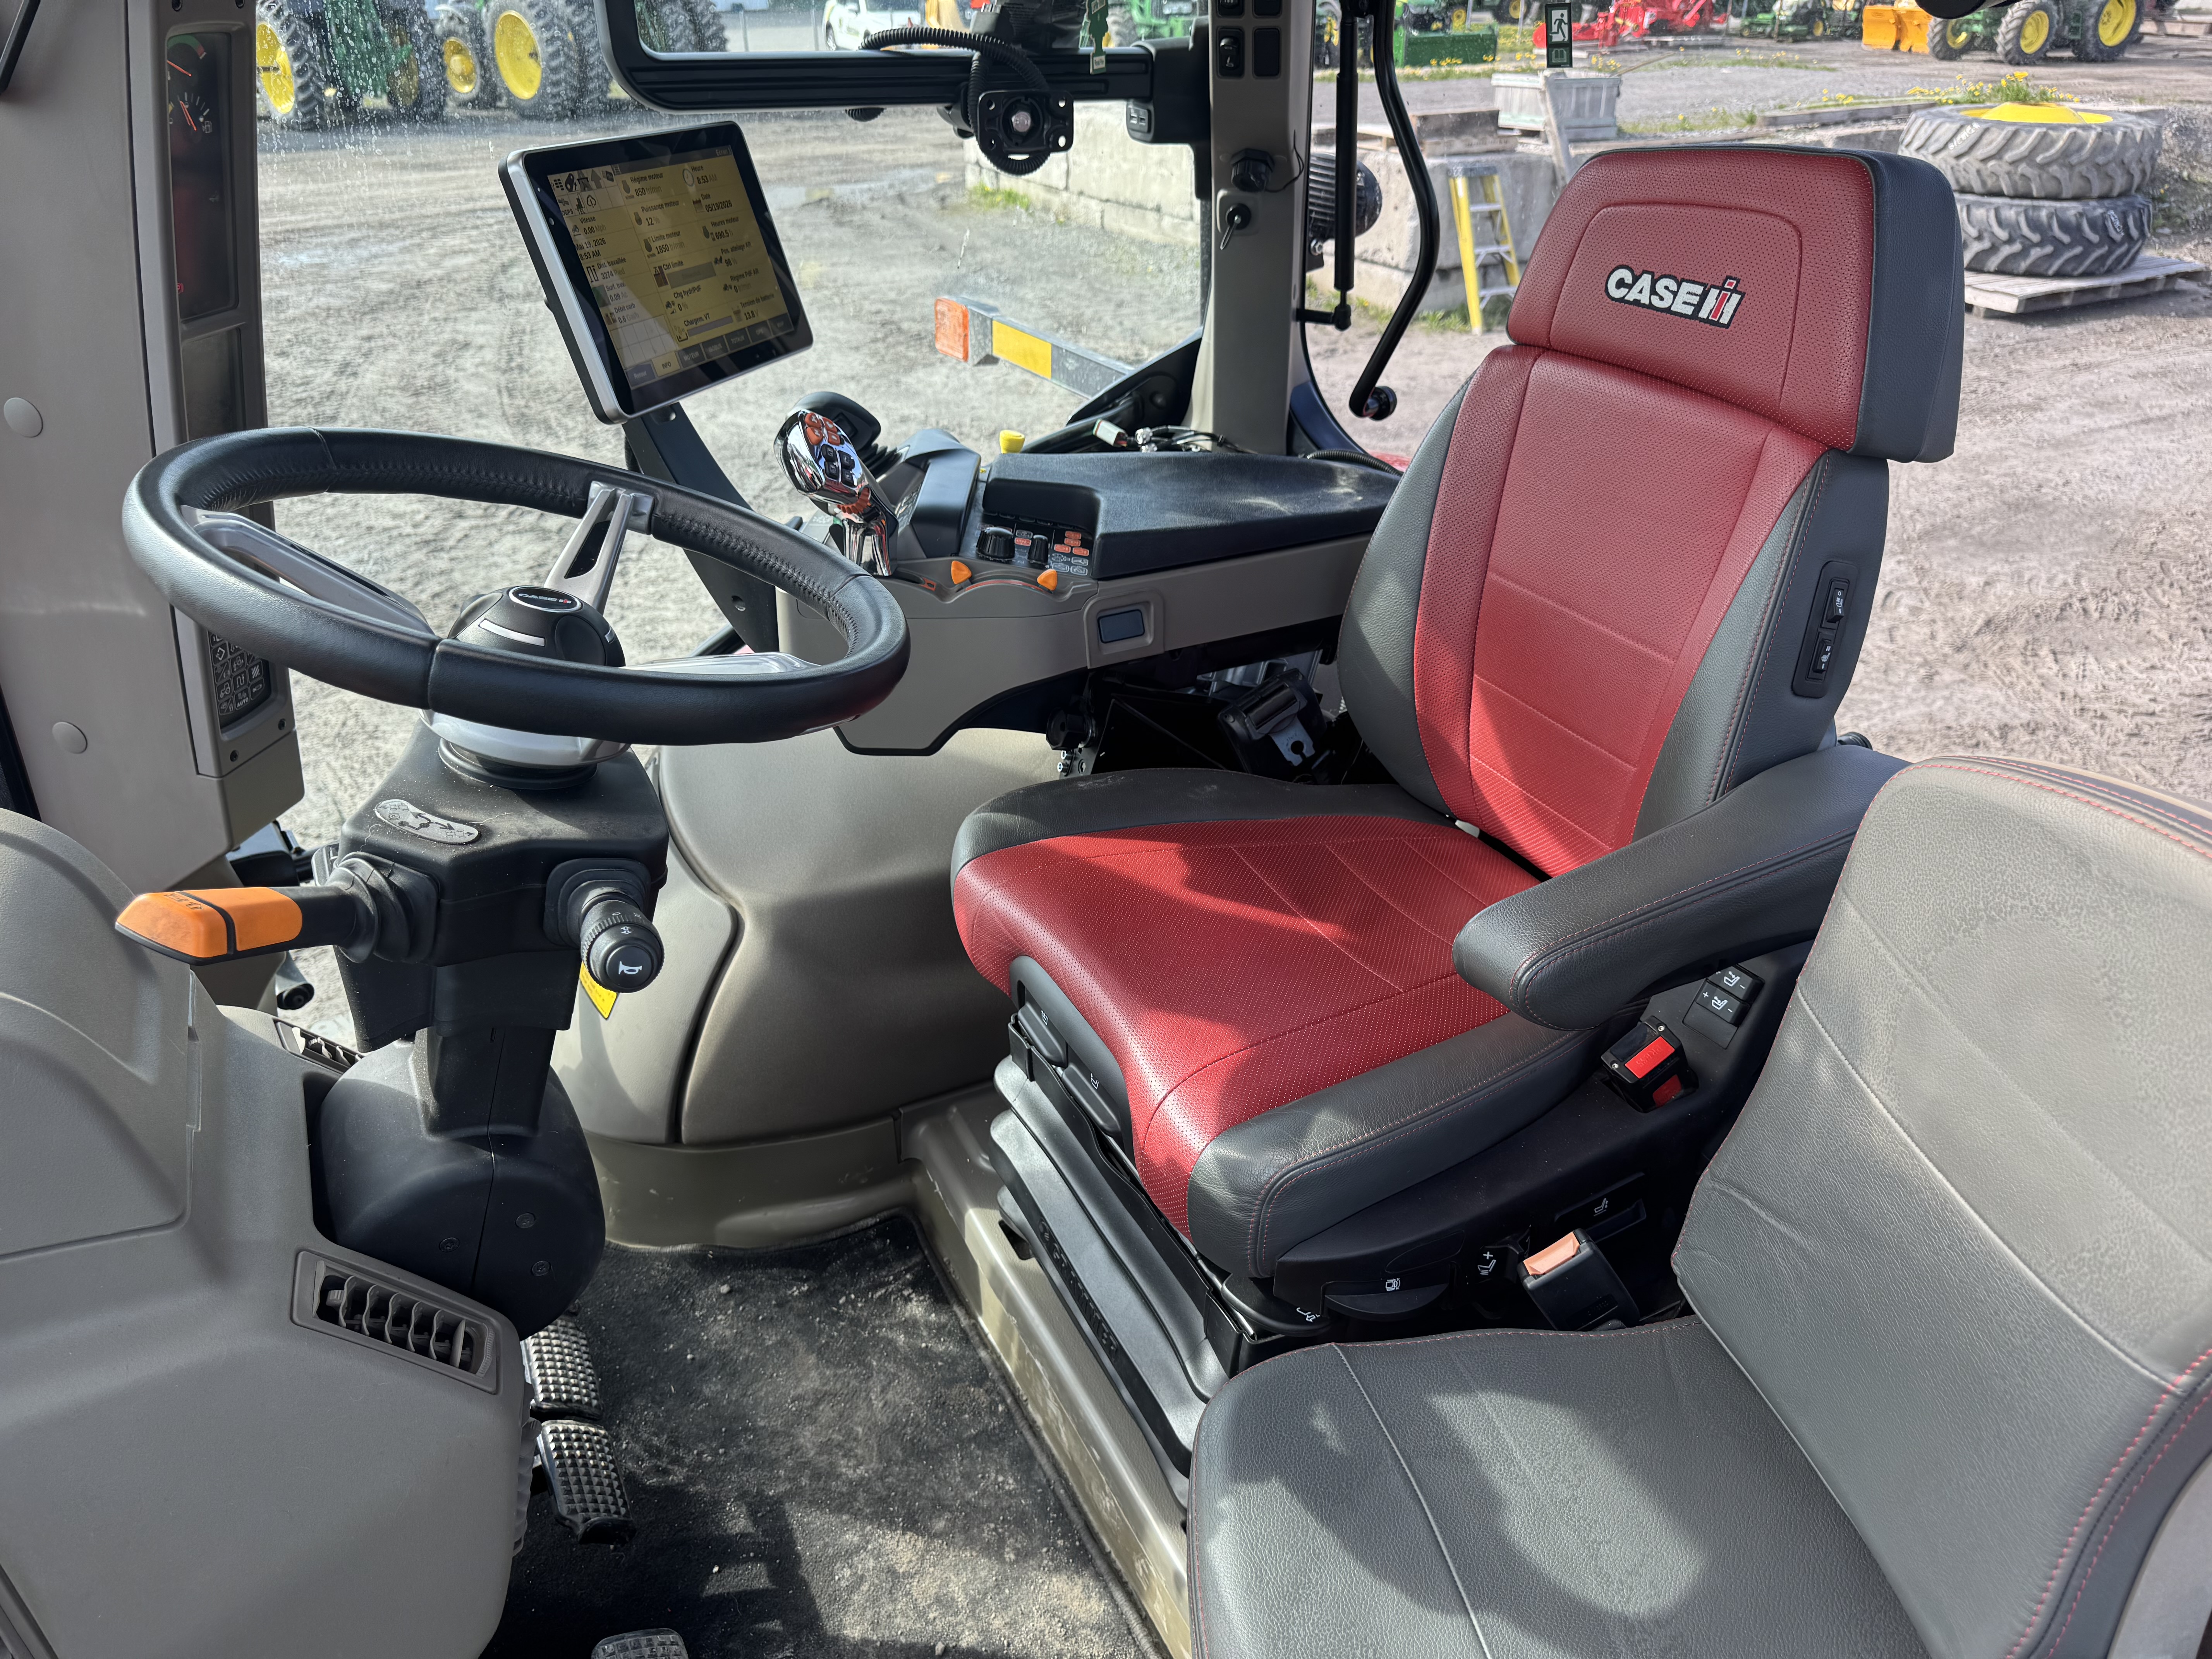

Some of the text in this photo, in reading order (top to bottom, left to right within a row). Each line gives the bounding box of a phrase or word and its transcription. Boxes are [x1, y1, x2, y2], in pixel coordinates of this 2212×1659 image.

[630, 176, 647, 184] Régime
[697, 174, 718, 184] 8:53 AM
[635, 185, 662, 197] 850 tr/min
[641, 200, 679, 213] Puissance moteur
[705, 199, 732, 212] 05/19/2026
[646, 217, 654, 226] 12
[584, 226, 595, 235] 0.00
[715, 230, 729, 240] 690.5
[593, 238, 606, 247] 2026
[651, 234, 665, 243] Limite
[656, 241, 685, 254] 1850 tr/min
[579, 250, 601, 261] 8:53 AM
[608, 257, 626, 266] travaillée
[725, 258, 732, 267] 98
[663, 263, 672, 271] Ctrl
[601, 271, 613, 279] 3274
[730, 273, 745, 282] Régime
[1607, 268, 1704, 315] CASE
[610, 294, 620, 302] 0.09
[740, 300, 755, 308] Tension
[614, 305, 626, 313] Débit
[618, 315, 627, 324] 0.6
[744, 309, 759, 321] 13.8 V
[684, 316, 704, 326] Chargem.
[684, 352, 700, 361] MOTEUR
[634, 371, 647, 380] Retour
[518, 593, 558, 602] CASE
[237, 697, 249, 708] AUTO
[1636, 1044, 1663, 1067] PRESS
